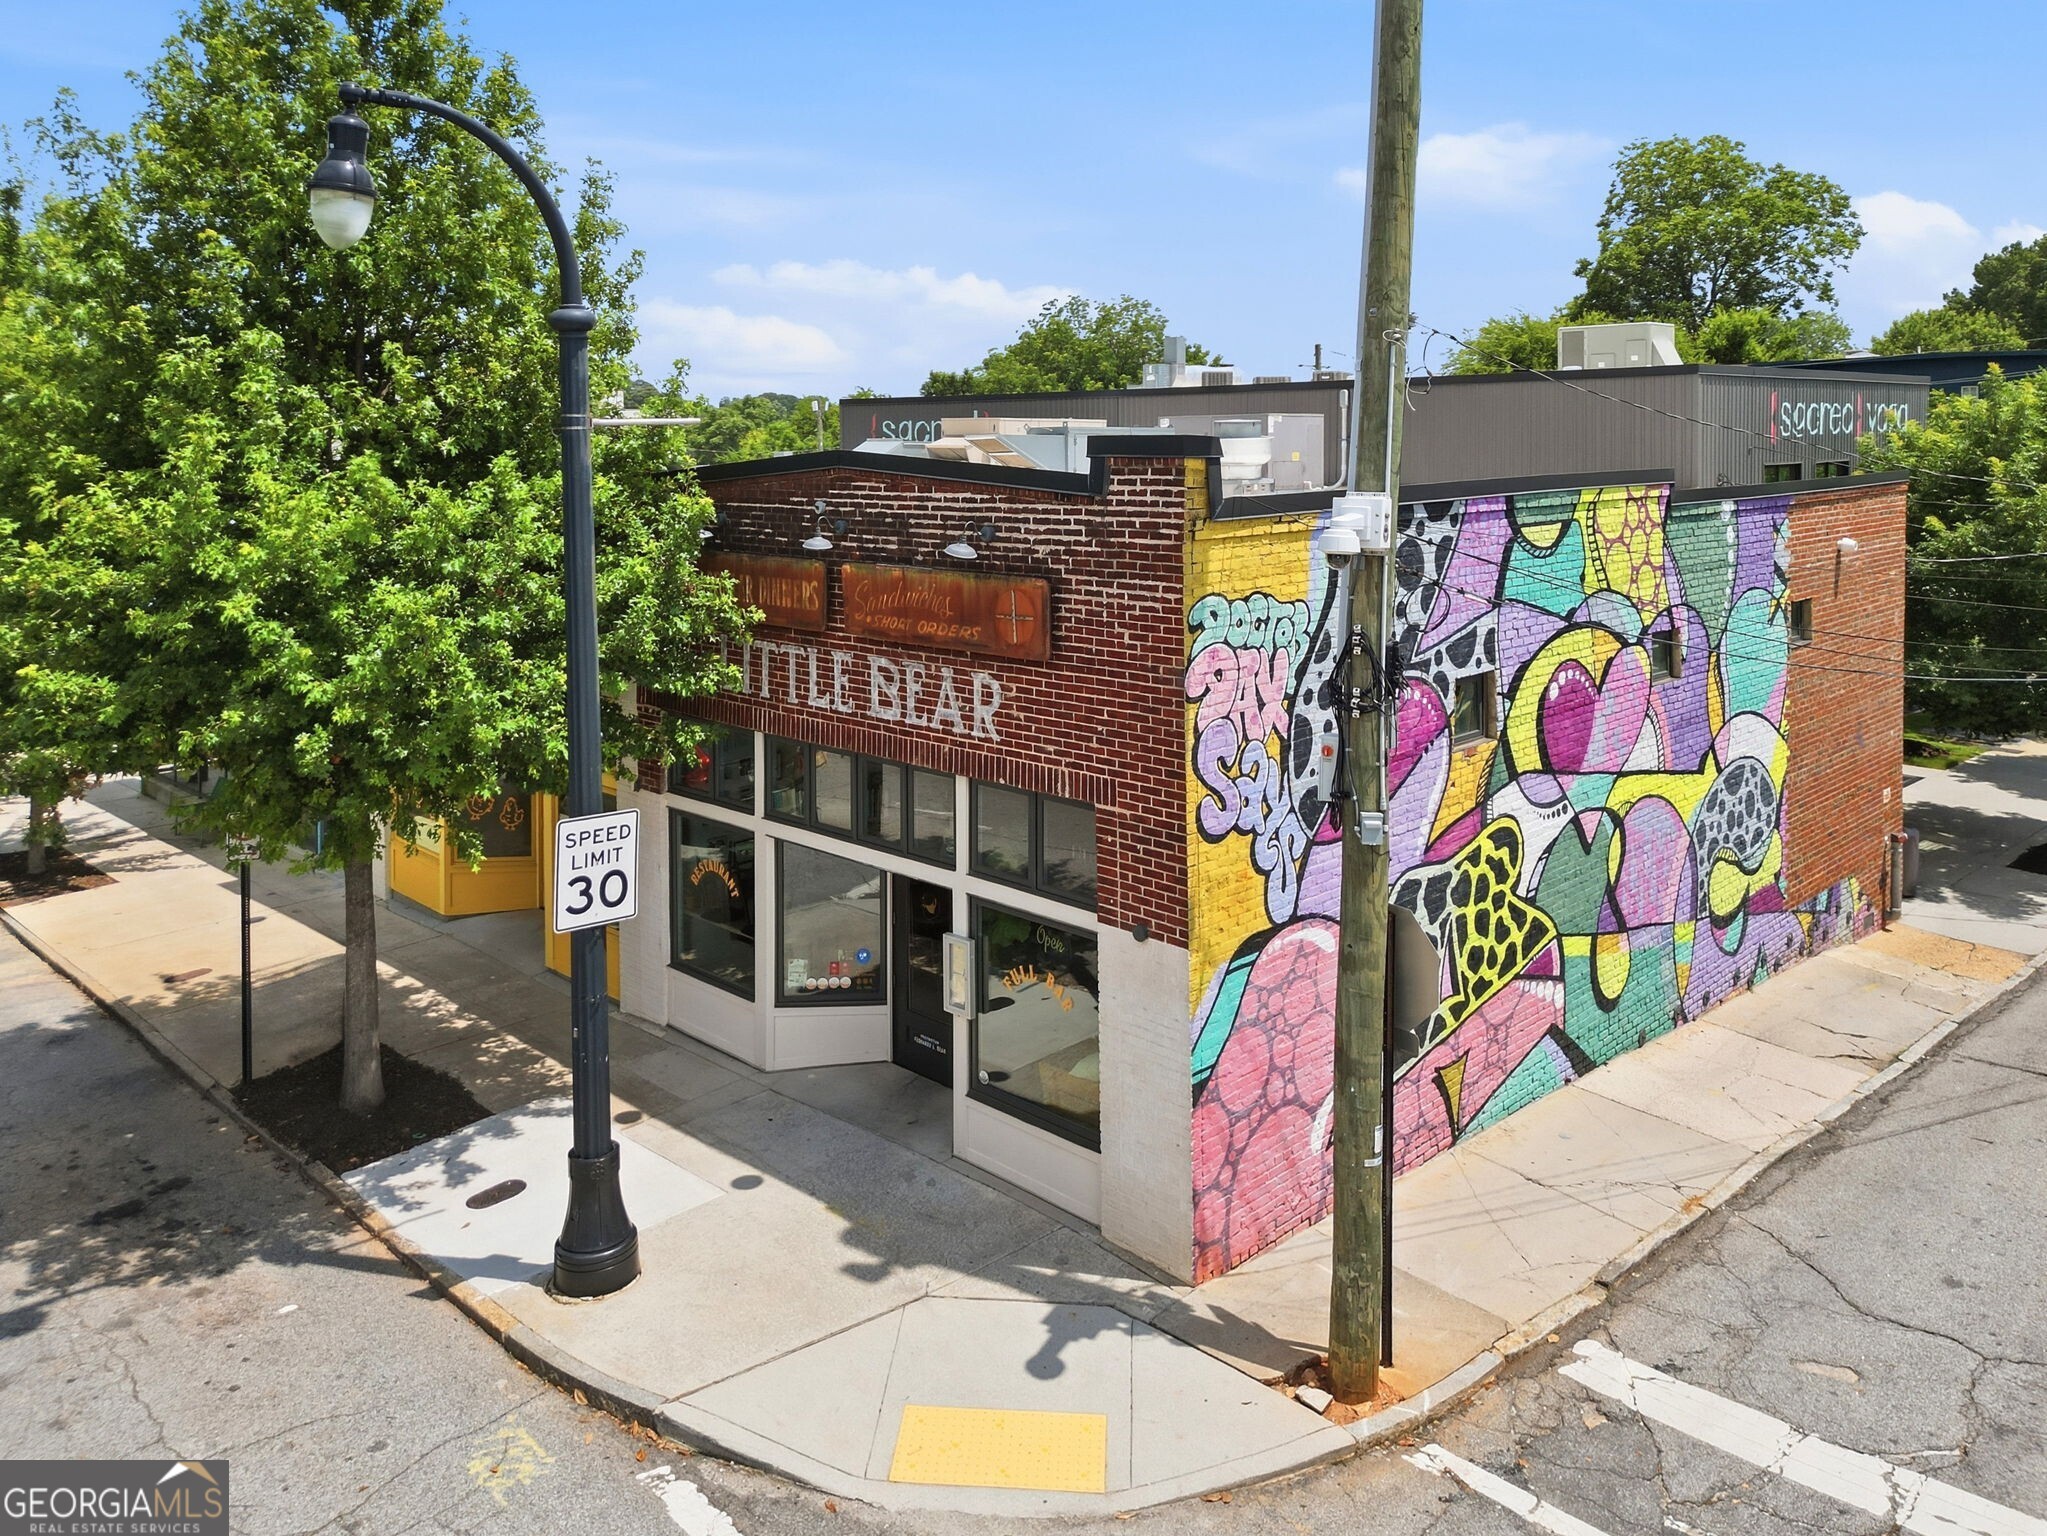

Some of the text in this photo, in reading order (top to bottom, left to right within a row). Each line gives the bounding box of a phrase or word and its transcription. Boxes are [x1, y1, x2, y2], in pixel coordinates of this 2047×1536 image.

[1780, 391, 1908, 437] sacred yoa
[854, 579, 954, 620] Sandwiches
[872, 614, 982, 641] SHORT ORDERS
[867, 655, 1002, 742] BEAR
[565, 824, 632, 849] SPEED
[571, 846, 624, 871] LIMIT
[690, 859, 740, 898] RESTAURANT
[565, 869, 629, 916] 30
[1036, 924, 1065, 953] Open
[1003, 964, 1038, 991] FULL
[1046, 972, 1074, 1014] BAR
